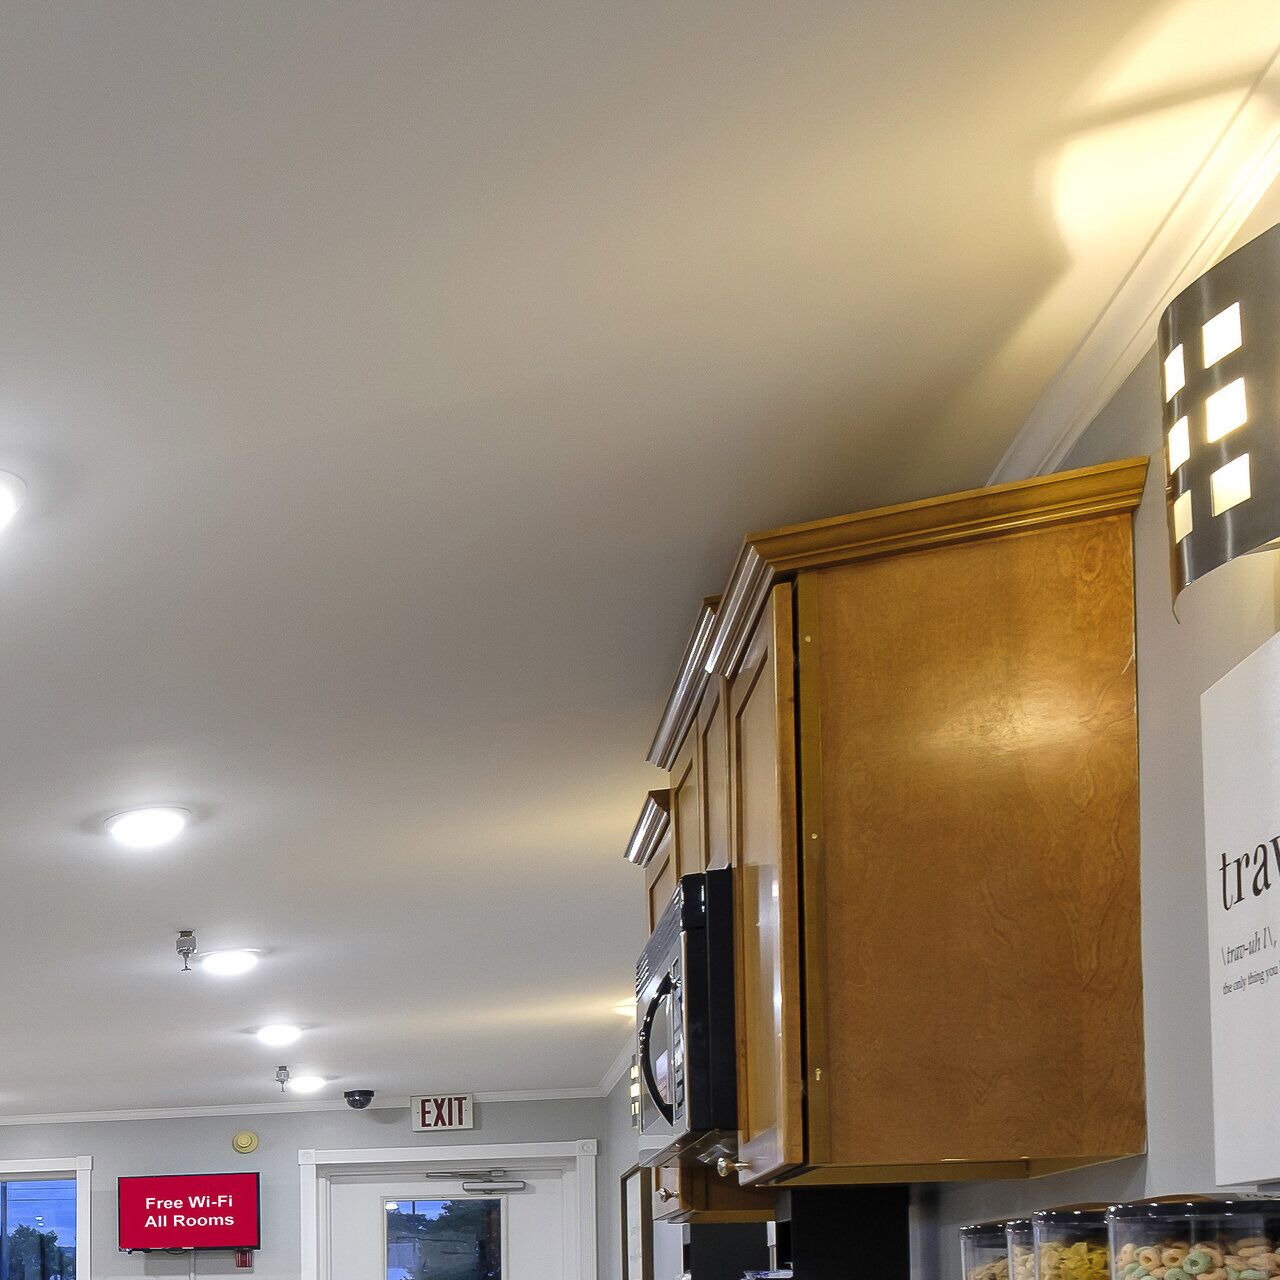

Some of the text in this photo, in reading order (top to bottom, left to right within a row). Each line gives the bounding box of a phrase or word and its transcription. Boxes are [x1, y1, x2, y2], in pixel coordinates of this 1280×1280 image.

[1265, 965, 1278, 984] you
[420, 1096, 467, 1128] EXIT
[145, 1195, 233, 1210] Free Wi-Fi
[144, 1214, 235, 1228] All Rooms
